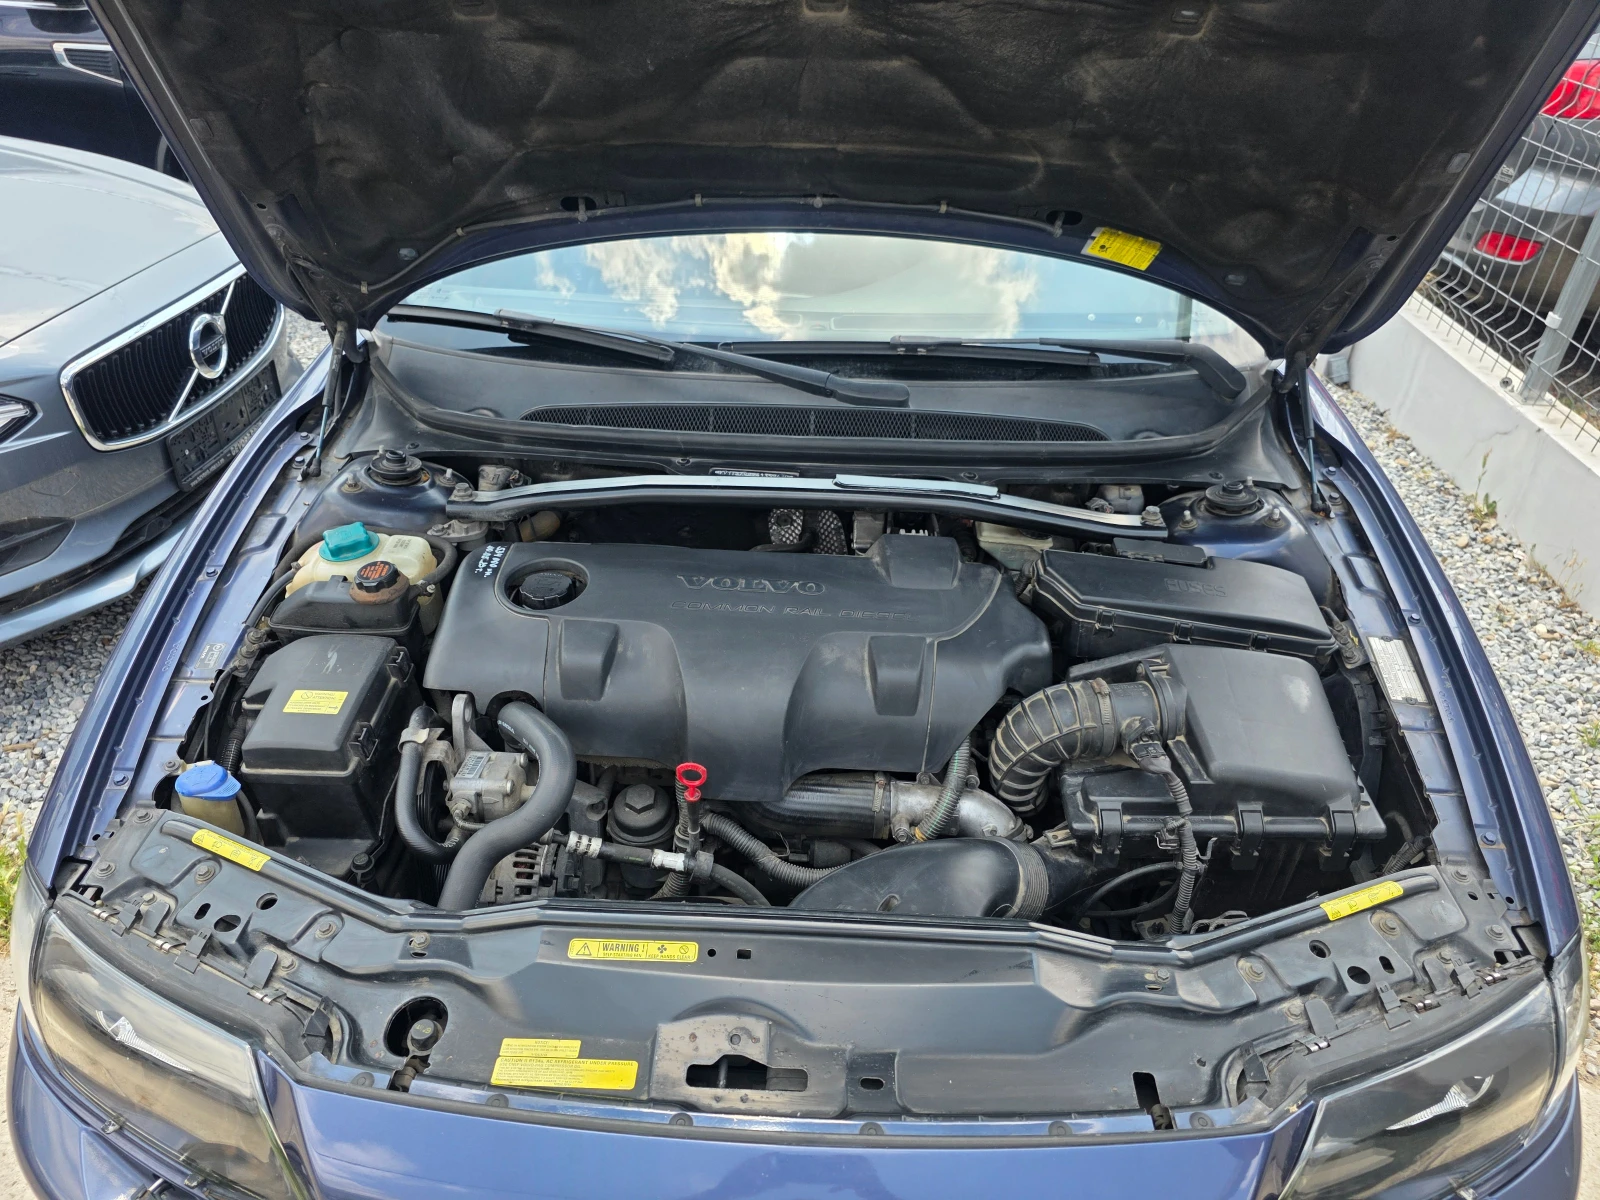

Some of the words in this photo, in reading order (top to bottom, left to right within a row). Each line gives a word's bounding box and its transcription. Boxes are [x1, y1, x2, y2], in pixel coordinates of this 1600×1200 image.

[677, 574, 825, 596] VOLVO
[1164, 578, 1228, 597] FUSES
[670, 600, 775, 613] COMMON
[783, 606, 831, 617] RAIL
[839, 608, 920, 622] DIESEL
[602, 942, 639, 952] WARNING
